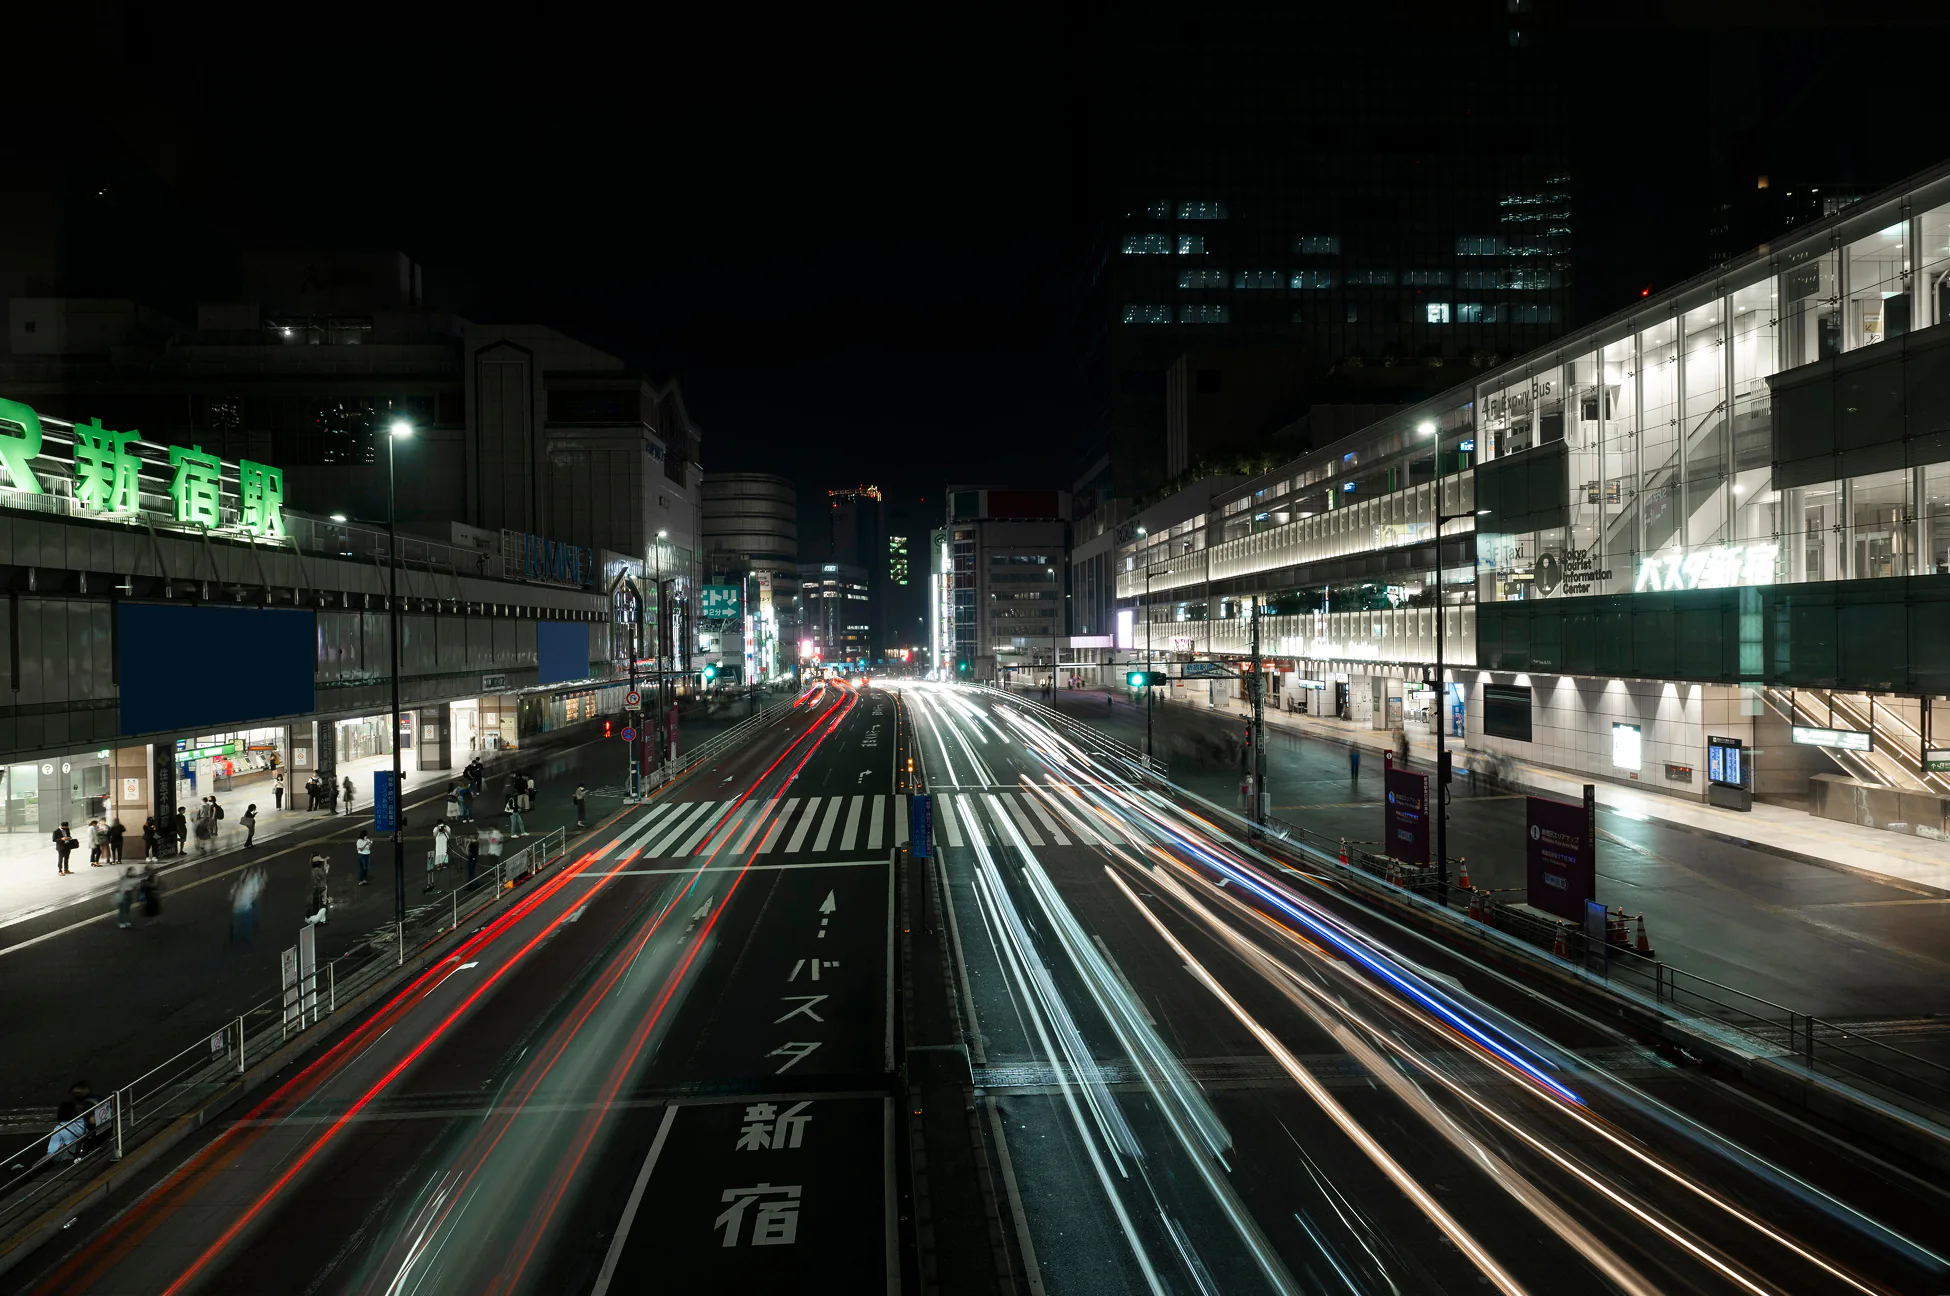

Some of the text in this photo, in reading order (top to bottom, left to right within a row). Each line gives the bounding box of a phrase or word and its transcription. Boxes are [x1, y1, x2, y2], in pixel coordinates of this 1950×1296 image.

[525, 532, 594, 586] LUMINE 2
[1503, 542, 1524, 567] Taxi
[1562, 547, 1587, 563] Tokyo
[1563, 558, 1592, 571] Tourist
[1562, 569, 1613, 583] Information
[1634, 544, 1780, 593] バスタ新宿
[1562, 582, 1591, 594] Center
[159, 768, 170, 829] 住友不動産
